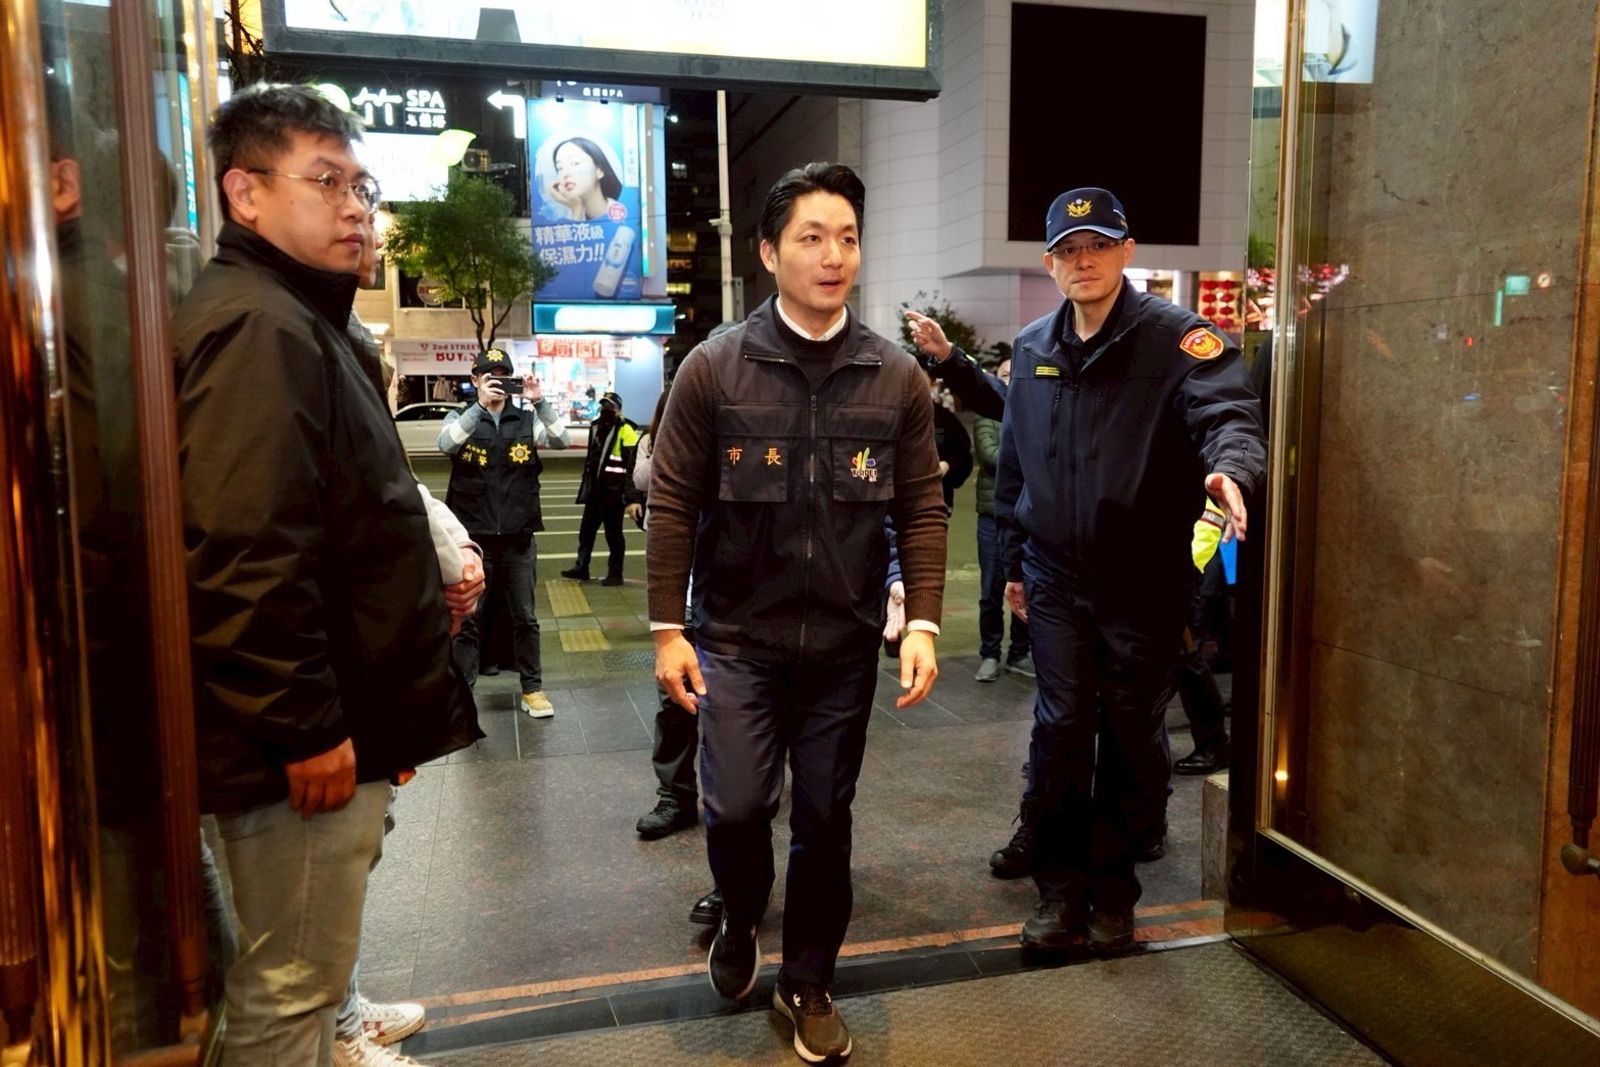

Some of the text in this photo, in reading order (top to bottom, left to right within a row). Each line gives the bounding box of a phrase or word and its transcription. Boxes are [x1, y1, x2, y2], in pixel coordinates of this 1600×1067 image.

[406, 89, 445, 108] SPA
[534, 223, 605, 246] 精華液級
[850, 468, 878, 480] TAIPEI
